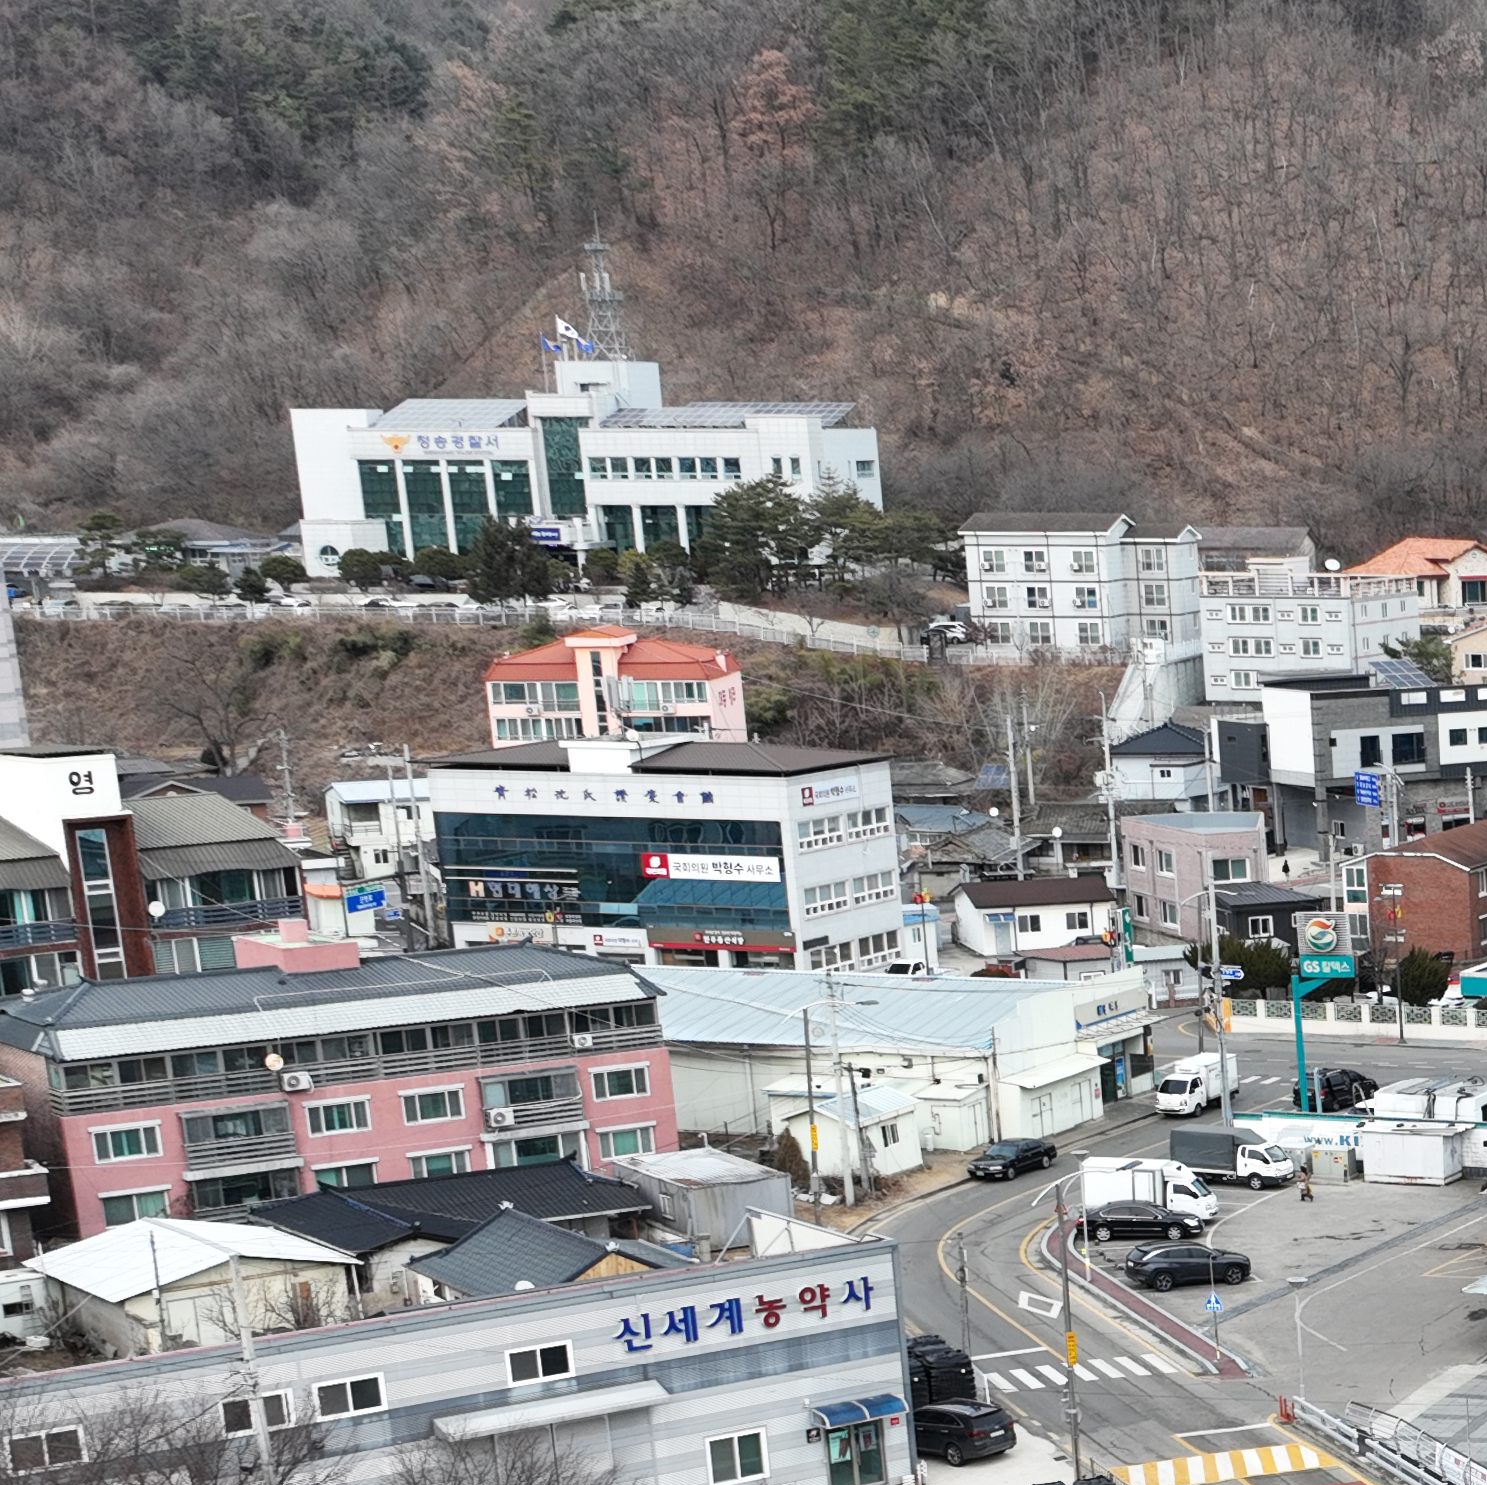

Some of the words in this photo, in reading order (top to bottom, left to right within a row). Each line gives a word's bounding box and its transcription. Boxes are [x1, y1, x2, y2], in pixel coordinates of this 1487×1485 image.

[68, 770, 95, 796] 영
[1303, 960, 1320, 973] GS
[1321, 960, 1351, 974] 칼텍스
[613, 1276, 874, 1353] 신세계농약사
